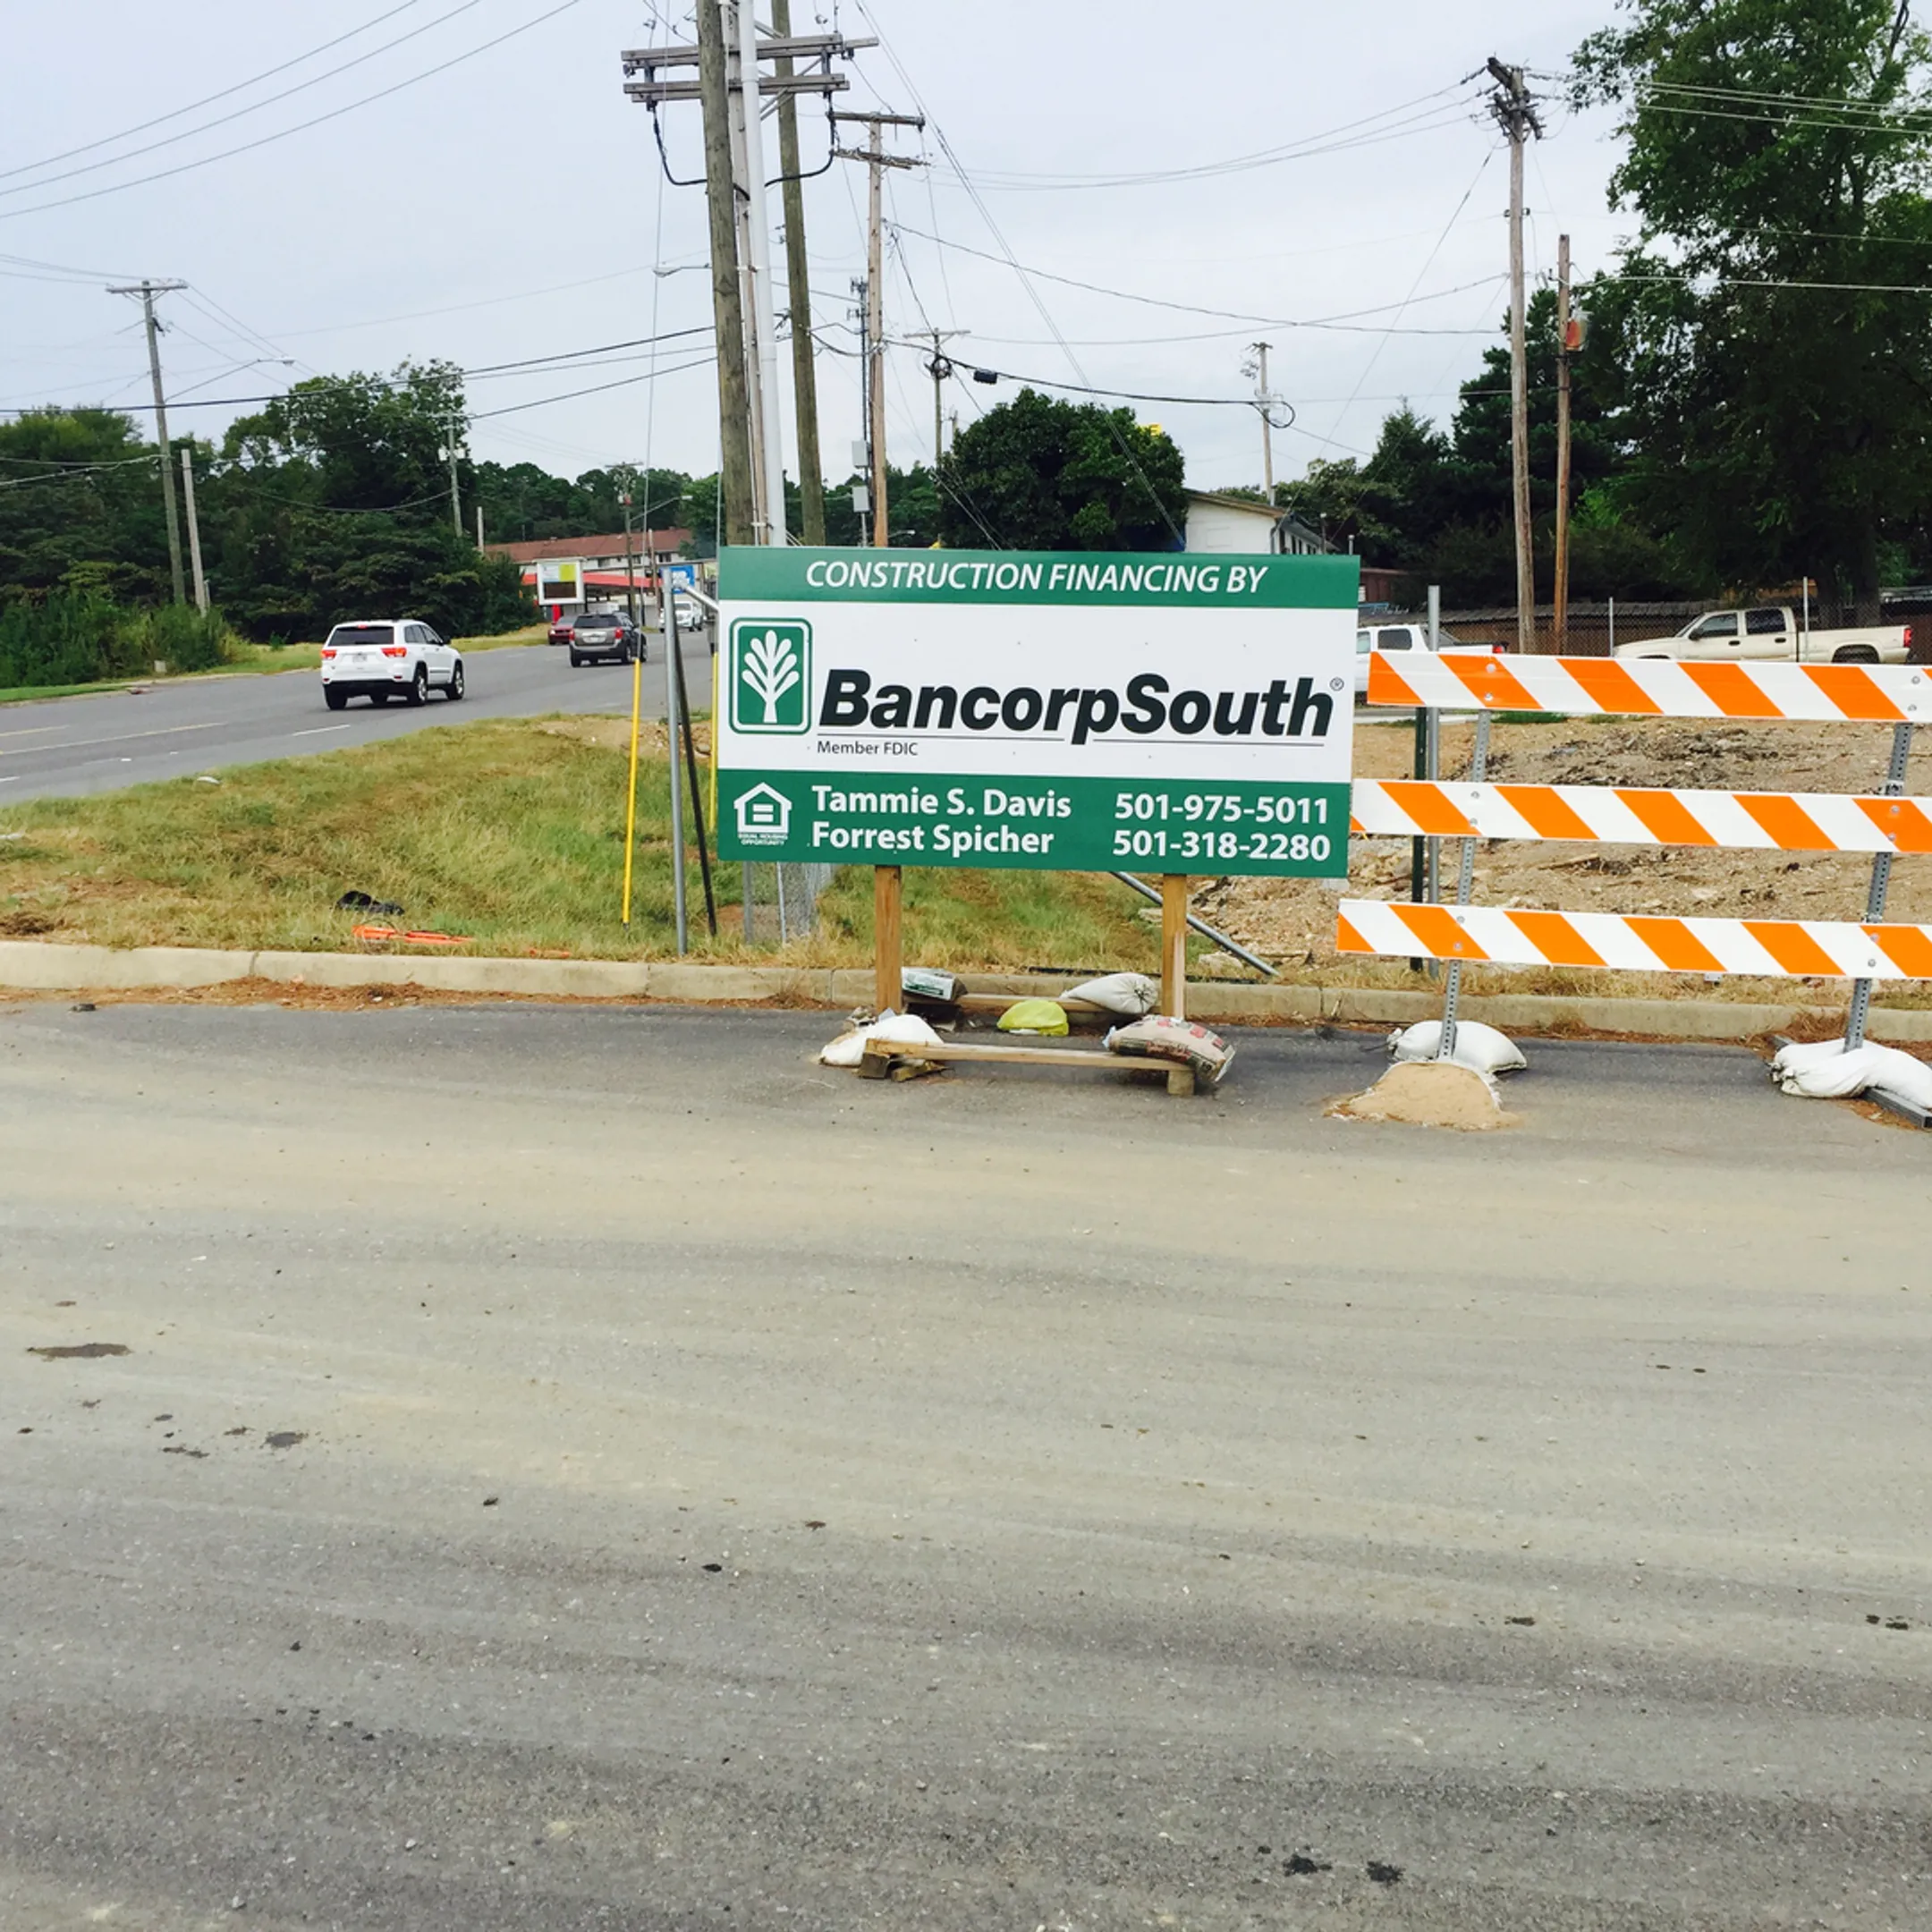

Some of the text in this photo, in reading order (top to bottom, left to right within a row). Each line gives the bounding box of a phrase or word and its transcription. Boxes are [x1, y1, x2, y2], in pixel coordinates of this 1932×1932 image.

[806, 561, 1269, 593] CONSTRUCTION FINANCING BY
[817, 740, 918, 756] Member FDIC
[811, 785, 1072, 818] Tammie S. Davis
[1114, 793, 1327, 826] 501-975-5011
[812, 821, 1055, 858] Forrest Spicher
[1113, 829, 1332, 861] 501-318-2280
